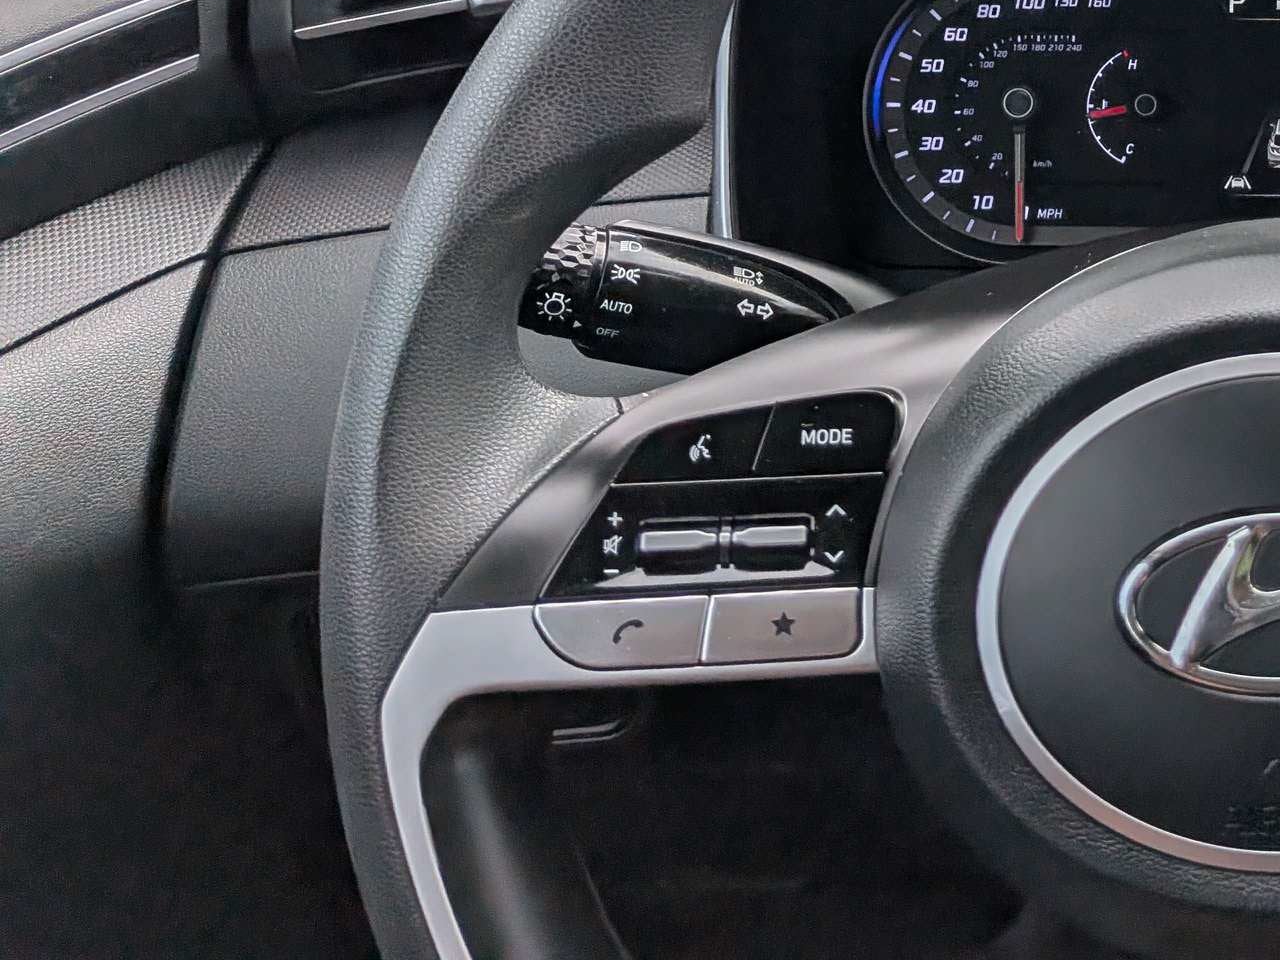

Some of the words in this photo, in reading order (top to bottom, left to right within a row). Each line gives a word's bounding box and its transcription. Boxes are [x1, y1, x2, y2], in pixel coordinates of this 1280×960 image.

[976, 4, 1001, 19] 80
[943, 27, 969, 42] 60
[1013, 43, 1028, 52] 150
[1047, 43, 1065, 52] 210
[1065, 43, 1083, 52] 240
[919, 58, 945, 73] 50
[1127, 58, 1138, 70] H
[910, 98, 937, 114] 40
[962, 107, 975, 116] 60
[918, 136, 944, 151] 30
[1125, 143, 1135, 155] C
[938, 168, 965, 184] 20
[973, 195, 994, 210] 10
[1036, 208, 1063, 219] MPH
[599, 298, 633, 315] AUTO
[595, 326, 620, 338] OFF
[800, 428, 853, 446] MODE
